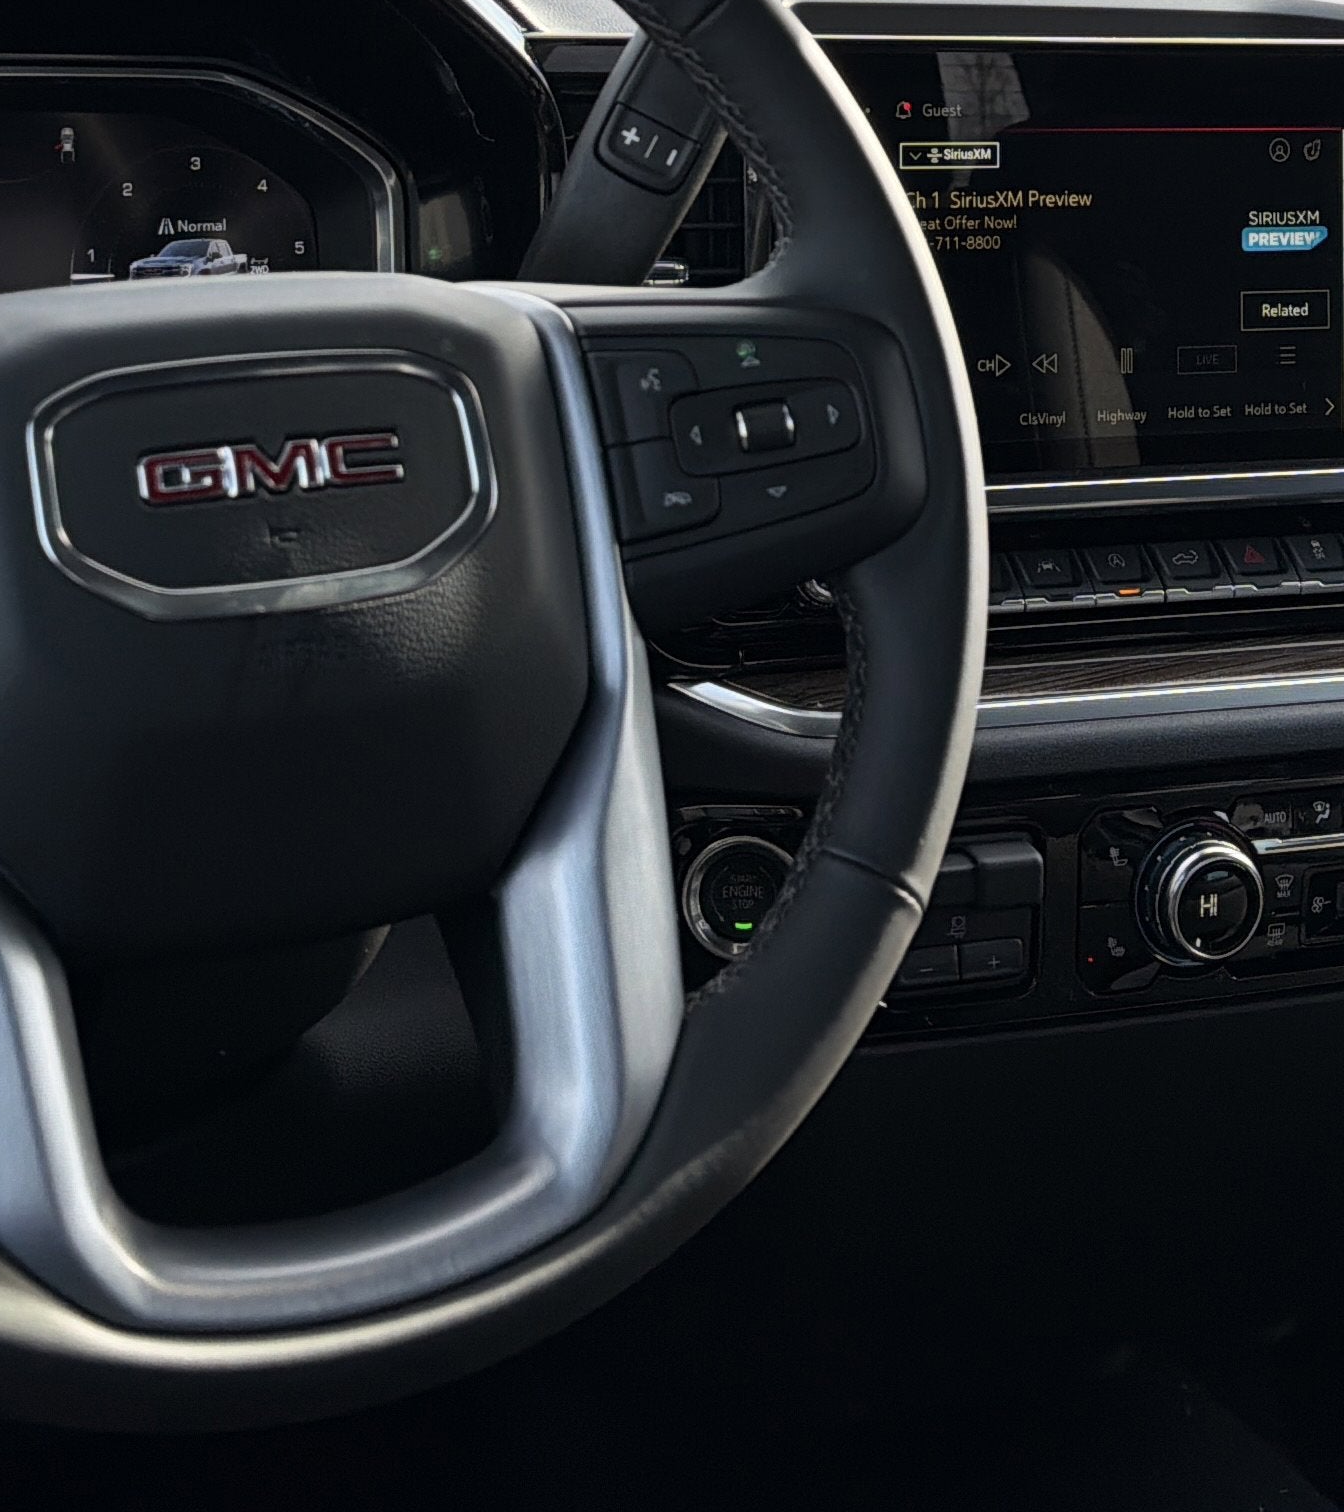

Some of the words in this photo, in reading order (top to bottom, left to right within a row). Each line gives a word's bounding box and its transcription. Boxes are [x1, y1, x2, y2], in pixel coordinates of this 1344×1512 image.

[922, 104, 962, 117] Guest
[943, 148, 991, 161] SiriusXM
[189, 156, 202, 172] 3
[121, 182, 134, 197] 2
[256, 179, 268, 194] 4
[931, 191, 939, 208] 1
[950, 191, 1023, 208] SiriusXM
[1028, 190, 1092, 207] Preview
[920, 217, 941, 230] eat
[944, 215, 980, 230] Offer
[984, 214, 1017, 229] Now!
[1248, 210, 1320, 226] SIRIUSXM
[177, 218, 227, 234] Normal
[929, 236, 1001, 251] -711-8800
[1248, 231, 1320, 246] PREVIEW
[86, 248, 96, 263] 1
[294, 241, 305, 255] 5
[1262, 302, 1308, 318] Related
[977, 360, 995, 372] CH
[1196, 354, 1219, 365] LIVE
[1097, 408, 1147, 424] Highway
[1168, 406, 1196, 418] Hold
[1199, 407, 1211, 418] to
[1213, 405, 1232, 418] Set
[1245, 403, 1272, 416] Hold
[1274, 404, 1286, 415] to
[1288, 402, 1307, 414] Set
[1020, 412, 1066, 427] ClsVinyl
[137, 433, 404, 505] GMC
[1264, 811, 1287, 824] AUTO
[722, 884, 764, 899] ENGINE
[1199, 893, 1219, 918] HI
